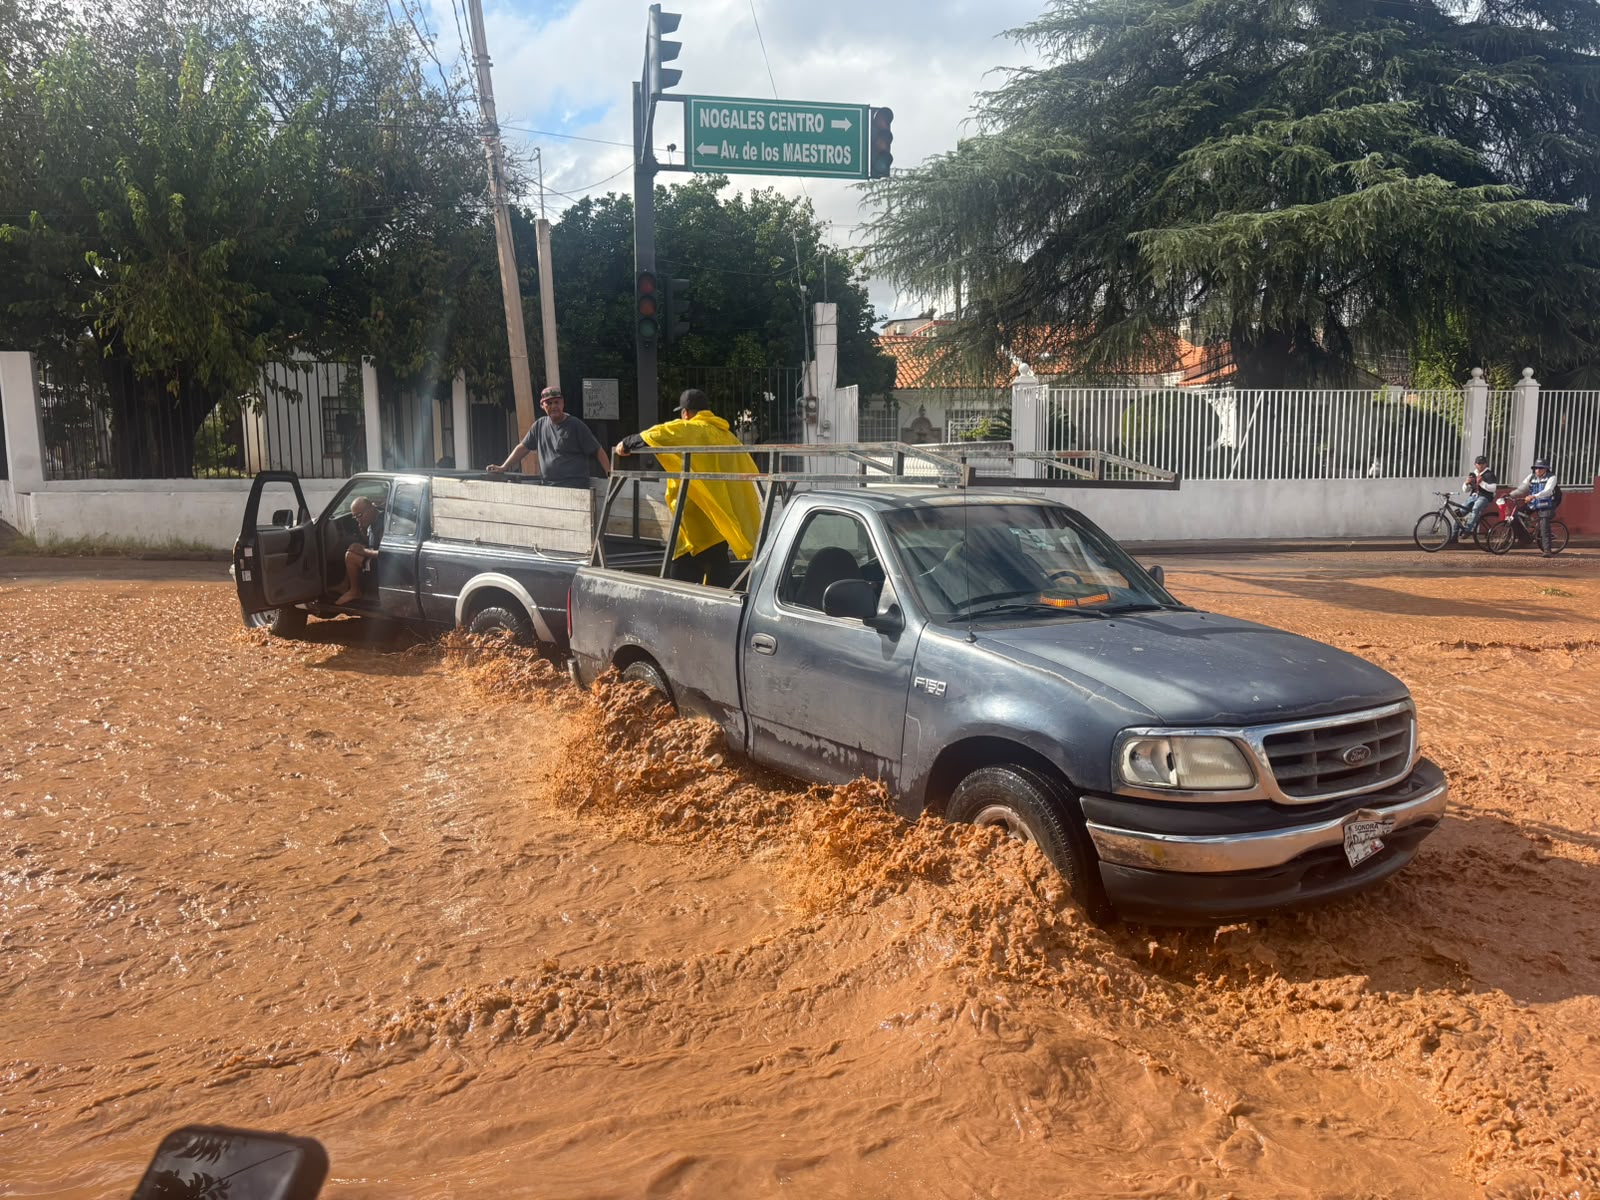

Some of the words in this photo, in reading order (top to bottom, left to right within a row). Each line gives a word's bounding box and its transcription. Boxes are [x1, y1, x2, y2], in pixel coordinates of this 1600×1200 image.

[700, 108, 765, 130] NOGALES
[769, 111, 824, 133] CENTRO
[720, 140, 739, 160] Av.
[742, 141, 757, 161] de
[761, 142, 779, 161] los
[783, 143, 851, 164] MAESTROS
[1350, 749, 1366, 762] Ford
[1354, 823, 1379, 832] SONORA
